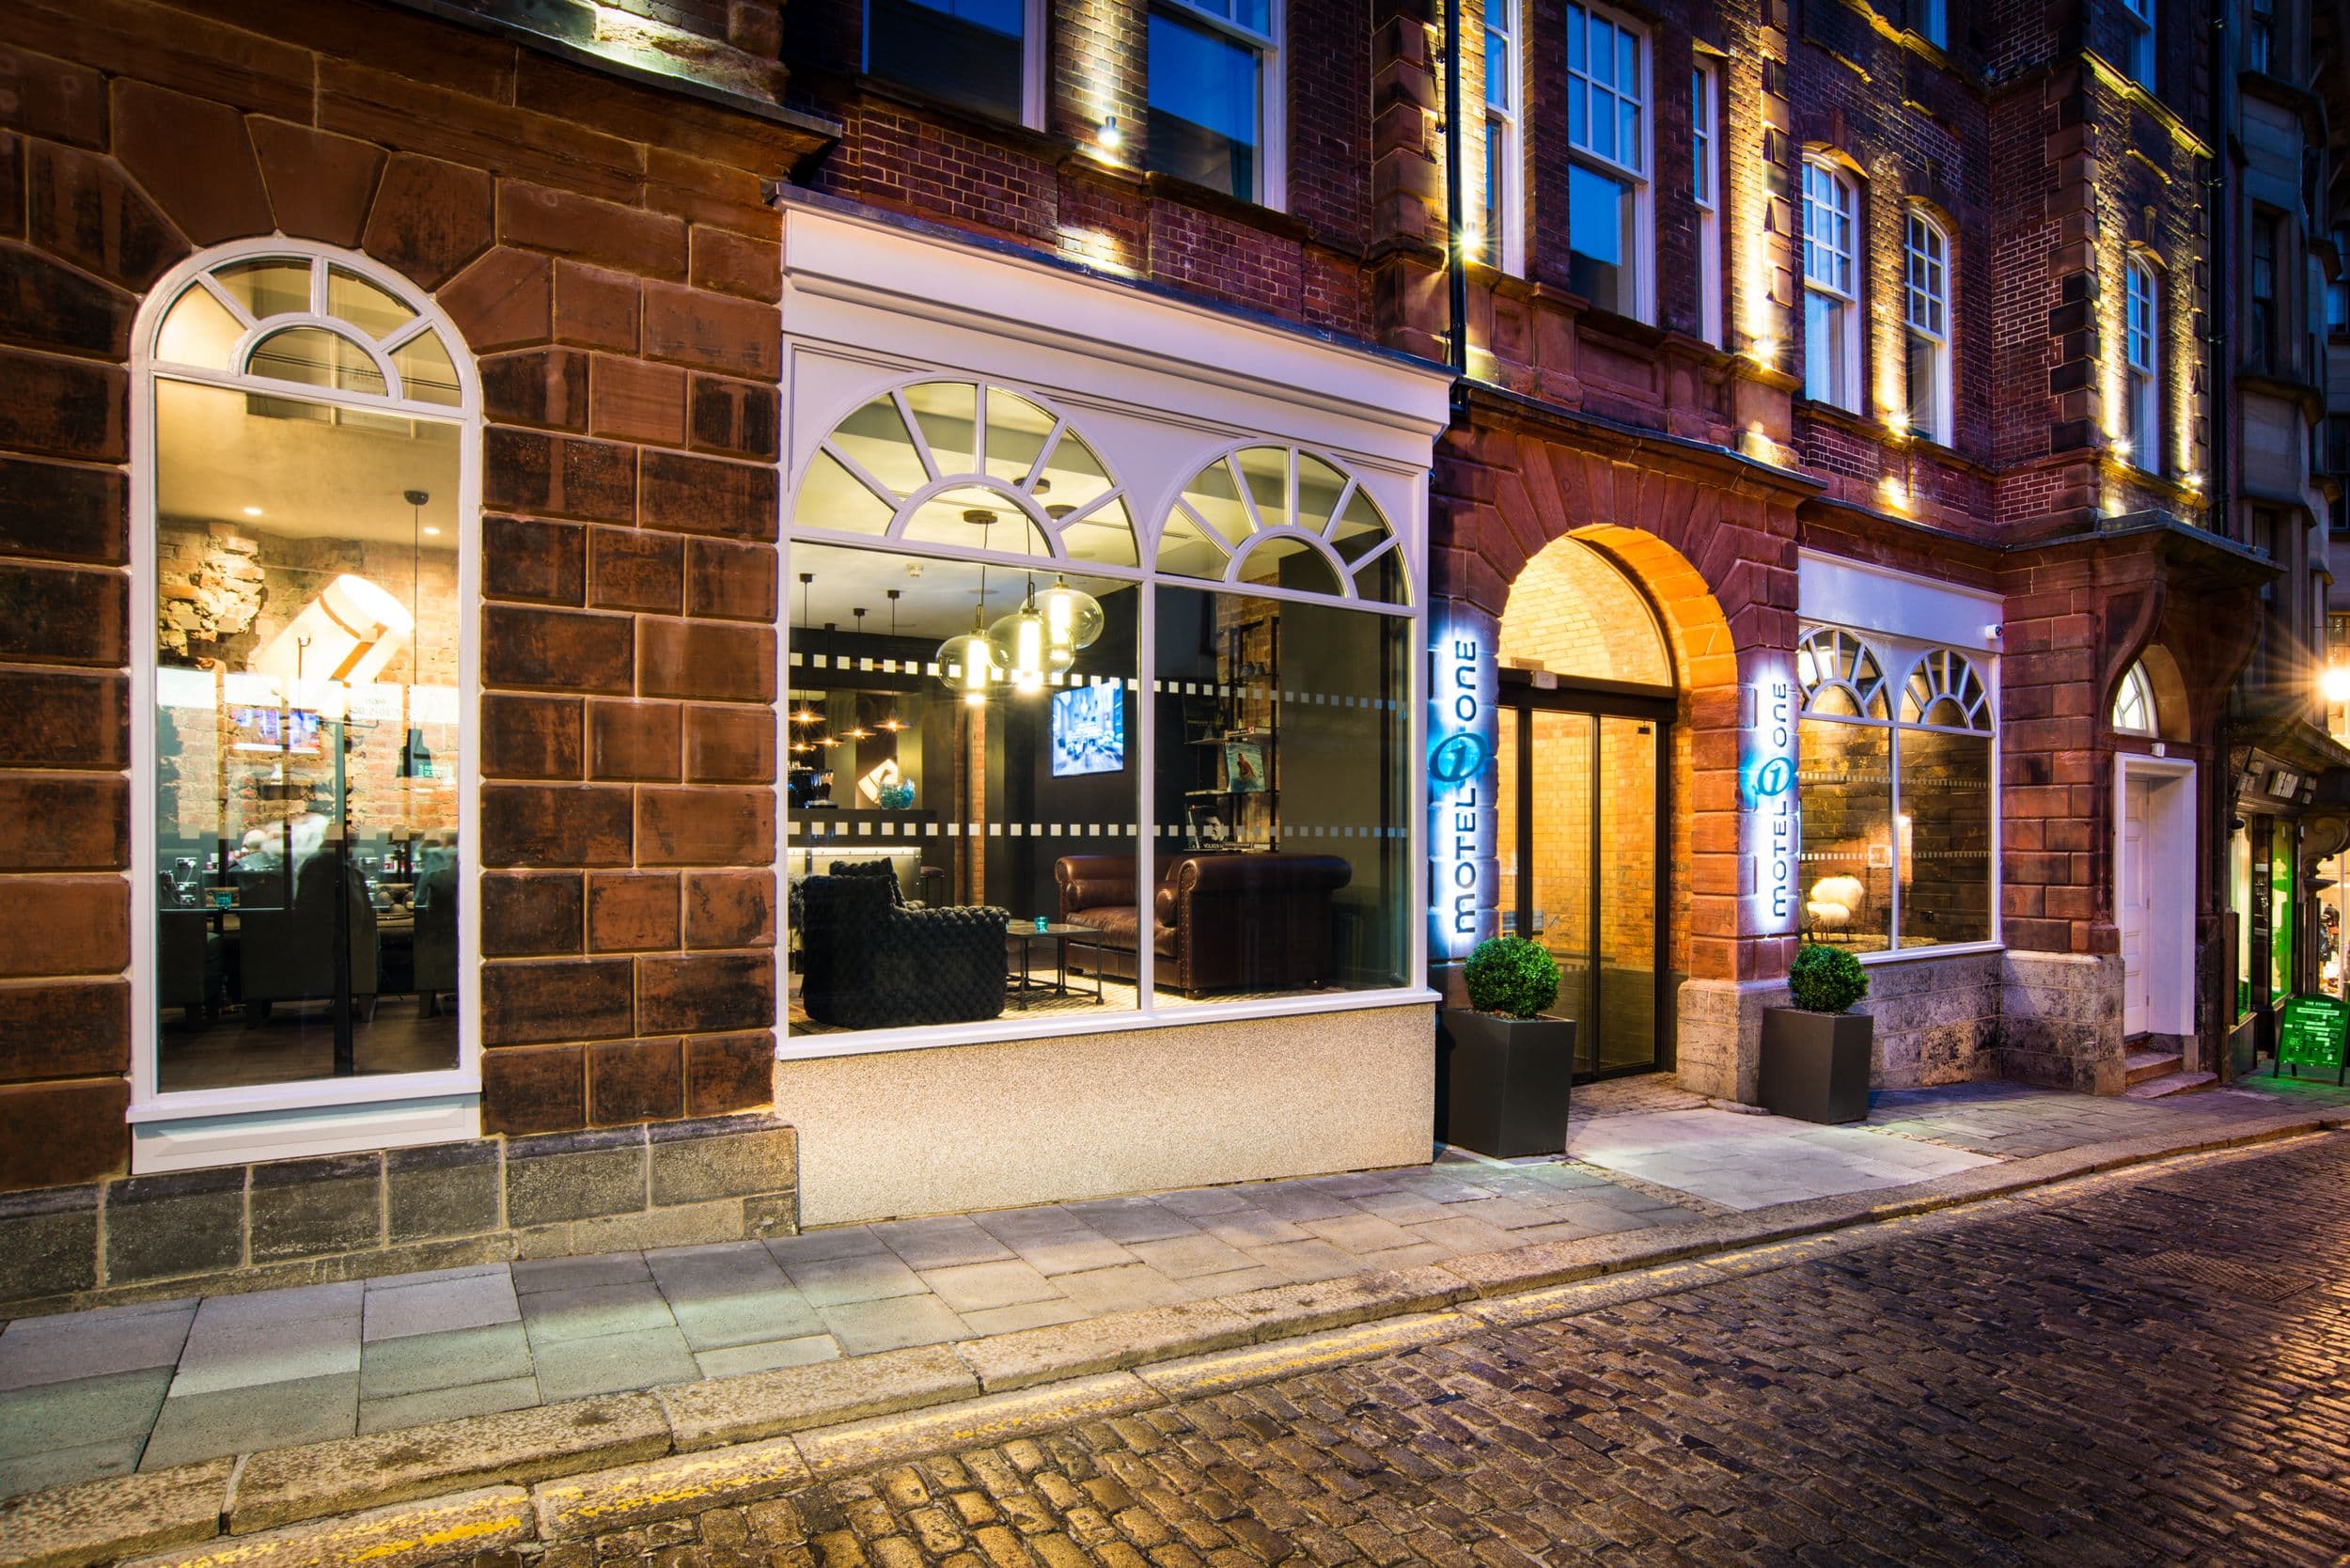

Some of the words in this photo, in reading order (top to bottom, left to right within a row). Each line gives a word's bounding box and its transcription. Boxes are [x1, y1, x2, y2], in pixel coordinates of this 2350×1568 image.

[1455, 640, 1477, 722] ONE
[1773, 682, 1787, 747] ONE
[1455, 788, 1477, 933] MOTEL
[1773, 800, 1787, 917] MOTEL
